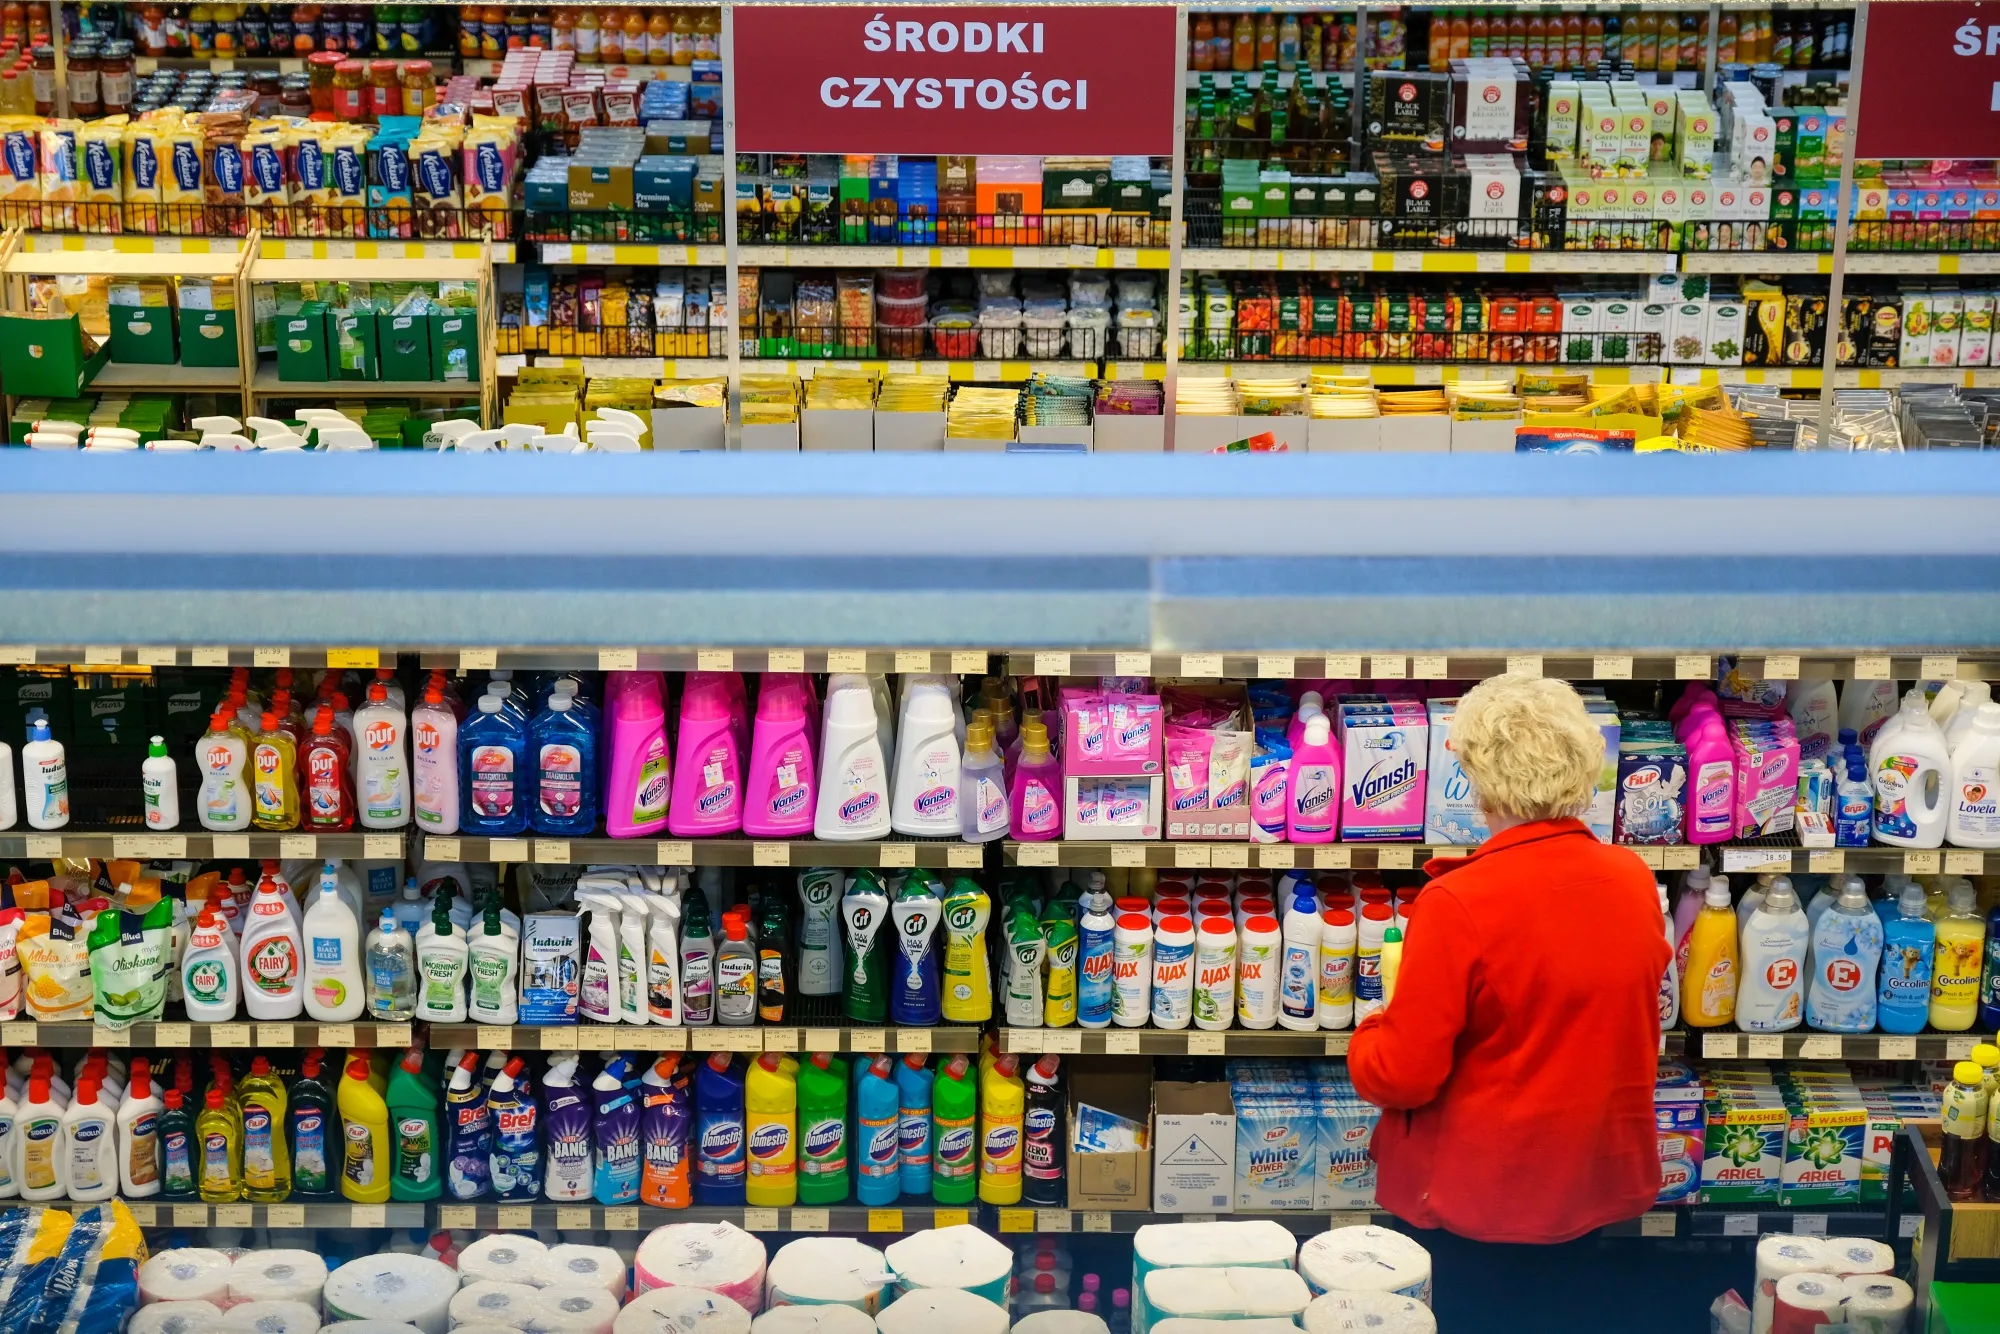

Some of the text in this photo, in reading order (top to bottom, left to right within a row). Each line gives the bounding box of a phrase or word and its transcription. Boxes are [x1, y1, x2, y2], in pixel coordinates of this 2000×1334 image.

[863, 13, 1044, 53] ŚRODKI
[819, 71, 1088, 110] CZYSTOŚCI
[1394, 102, 1420, 110] BLACK
[1395, 108, 1419, 116] LABEL
[88, 143, 109, 187] Krakuski
[136, 141, 151, 187] Krakuski
[176, 143, 194, 188] Krakuski
[219, 145, 236, 191] Krakuski
[256, 147, 275, 191] Krakuski
[301, 142, 317, 187] Krakuski
[337, 149, 354, 194] Krakuski
[383, 146, 400, 191] Krakuski
[480, 144, 496, 190] Krakuski
[423, 155, 445, 195] Krakuski
[1406, 205, 1431, 213] LABEL
[259, 647, 281, 656] 10.99
[20, 687, 49, 699] Knorr
[93, 699, 122, 710] Knorr
[366, 727, 395, 745] pur
[416, 727, 439, 745] pur
[1122, 724, 1150, 744] Vanish
[1801, 736, 1826, 753] anish
[209, 751, 231, 766] pur
[257, 753, 278, 770] pur
[311, 757, 334, 775] pur
[1753, 756, 1762, 764] 20
[479, 773, 508, 781] MAGNOLIA
[546, 772, 575, 781] MAGNOLIA
[1352, 757, 1417, 809] Vanish
[1878, 777, 1904, 790] Coccolino
[640, 774, 667, 808] Vanish
[699, 786, 731, 811] Vanish
[772, 786, 805, 811] Vanish
[917, 788, 951, 810] Vanish
[1175, 788, 1209, 810] Vanish
[1260, 780, 1287, 804] Vanish
[1702, 783, 1729, 805] Vanish
[843, 792, 875, 818] Vanish
[1297, 785, 1334, 816] Vanish
[1632, 790, 1668, 814] SÓL
[1844, 804, 1867, 814] Bryza
[1958, 800, 1997, 814] Lovela
[1026, 803, 1052, 825] Vanish
[1109, 801, 1138, 819] Vanish
[1765, 854, 1787, 862] 18.50
[808, 885, 830, 900] Cif
[852, 908, 870, 926] Cif
[905, 914, 926, 934] Cif
[953, 908, 974, 926] Cif
[52, 928, 74, 940] Blue
[122, 933, 141, 942] Blue
[532, 935, 574, 947] ludwik
[28, 949, 59, 962] Mleko
[259, 953, 285, 969] FAIRY
[1021, 951, 1035, 962] Cif
[1060, 949, 1073, 960] Cif
[425, 962, 458, 971] MORNING
[472, 960, 504, 970] MORNING
[588, 964, 607, 974] ludwik
[721, 962, 752, 971] ludwik
[1084, 951, 1113, 976] AJAX
[195, 975, 215, 986] FAIRY
[430, 969, 453, 978] FRESH
[477, 969, 498, 977] FRESH
[1157, 962, 1187, 984] AJAX
[1201, 963, 1231, 987] AJAX
[1772, 961, 1795, 987] E
[1831, 962, 1856, 988] E
[1938, 975, 1980, 986] Coccolino
[1888, 977, 1931, 989] Coccolino
[500, 1105, 536, 1129] Bref
[1025, 1115, 1055, 1127] Domestos
[1738, 1113, 1784, 1121] WASHES
[1809, 1115, 1865, 1125] 5 WASHES
[702, 1128, 743, 1148] Domestos
[750, 1131, 789, 1148] Domestos
[804, 1128, 844, 1148] Domestos
[939, 1134, 974, 1152] Domestos
[985, 1132, 1019, 1148] Domestos
[554, 1141, 587, 1158] BANG
[607, 1141, 639, 1162] BANG
[646, 1143, 679, 1163] BANG
[1027, 1143, 1048, 1156] ZERO
[1250, 1148, 1299, 1165] White
[1329, 1149, 1369, 1165] Whit
[1250, 1162, 1283, 1174] POWER
[1330, 1162, 1363, 1174] POWER
[1716, 1168, 1766, 1179] ARIEL
[1797, 1170, 1846, 1182] ARIEL
[1088, 1214, 1104, 1222] 3.50
